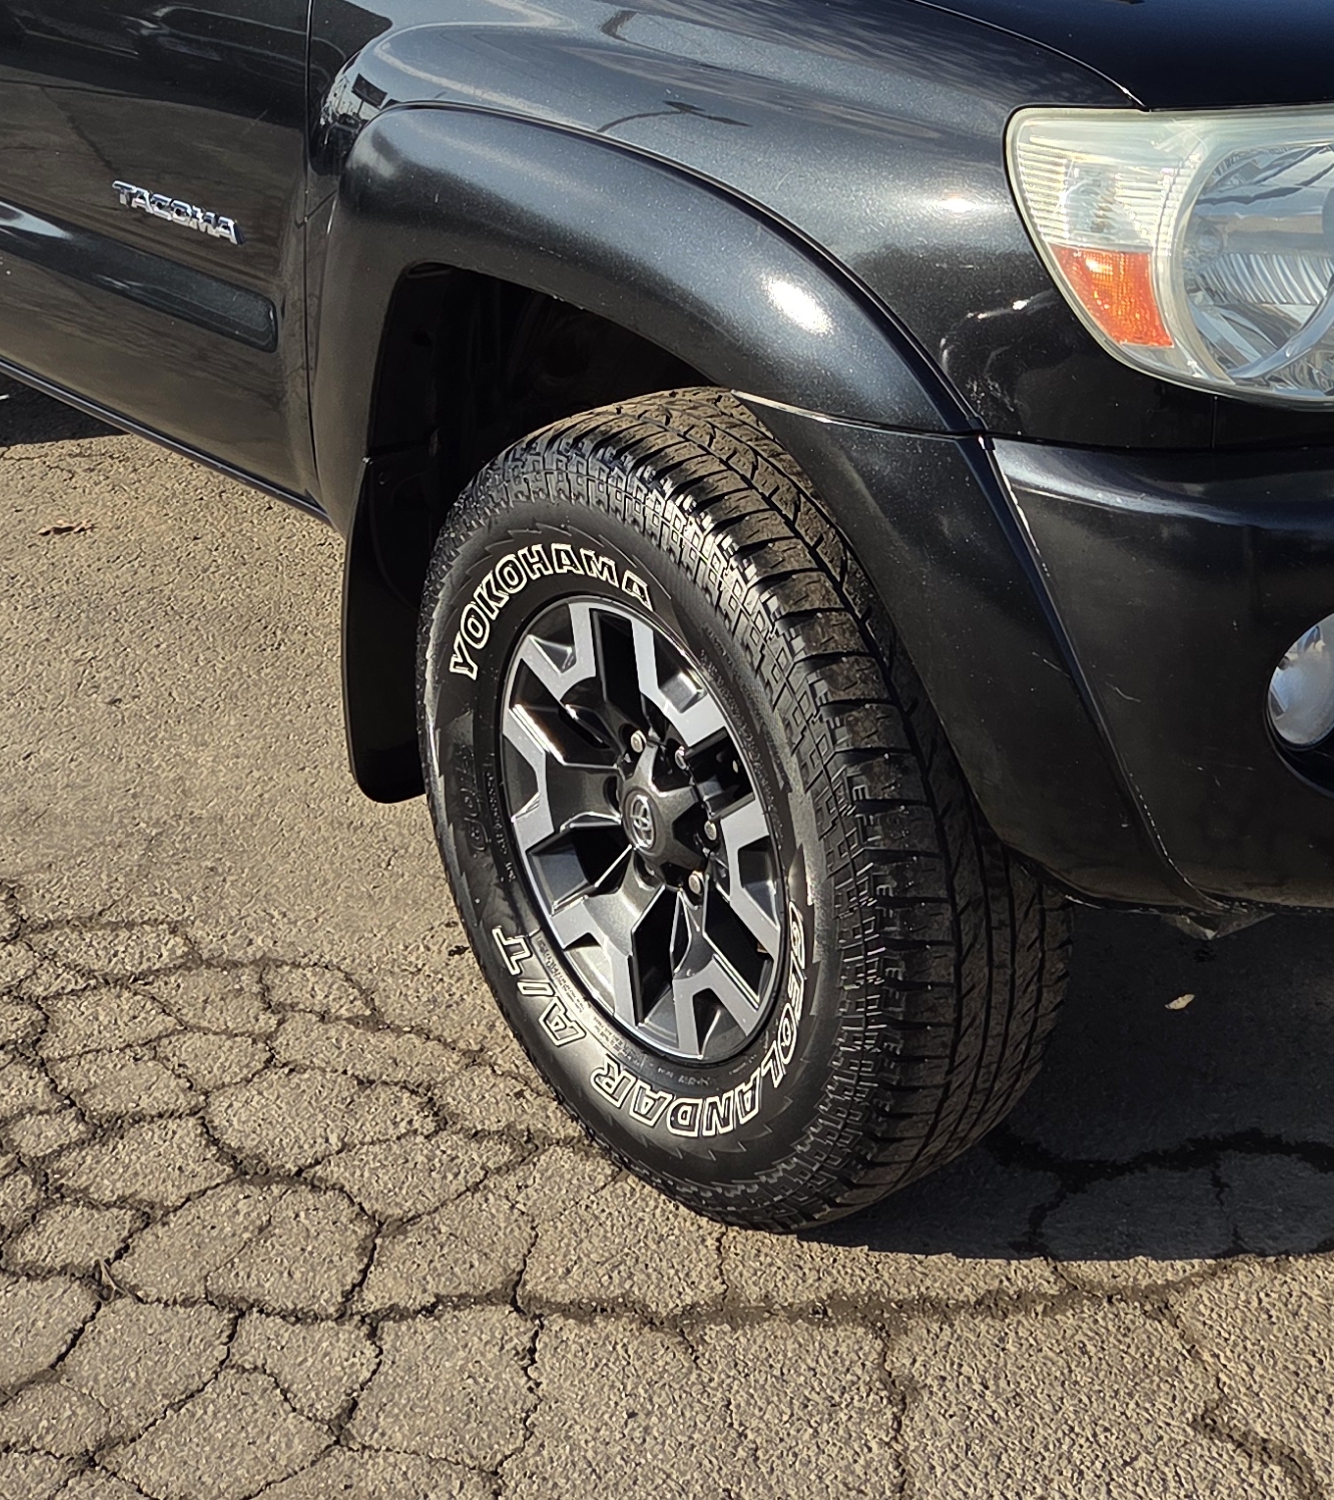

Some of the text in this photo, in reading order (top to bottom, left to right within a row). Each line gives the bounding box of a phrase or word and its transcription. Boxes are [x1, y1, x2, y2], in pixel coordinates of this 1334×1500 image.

[112, 180, 244, 245] TACOMA
[449, 543, 654, 681] YOKOHAMA
[492, 925, 586, 1047] A/T
[590, 901, 807, 1137] GEOLANDAR
